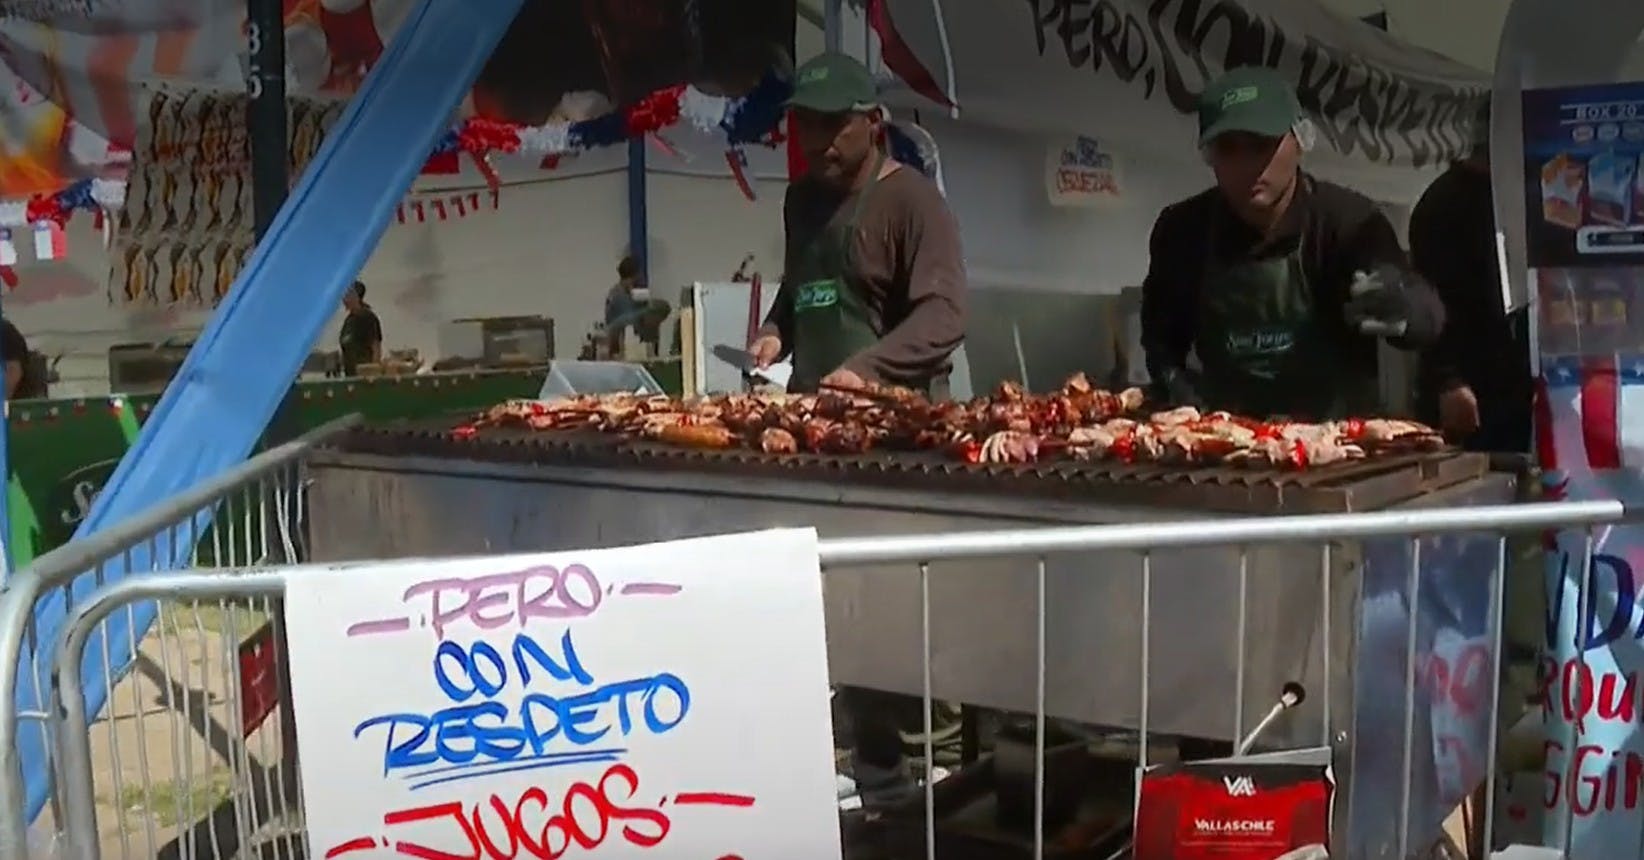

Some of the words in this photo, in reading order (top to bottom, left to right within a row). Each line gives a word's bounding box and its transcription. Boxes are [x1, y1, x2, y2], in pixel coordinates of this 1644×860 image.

[403, 563, 602, 640] PERO
[433, 628, 594, 701] CON
[353, 672, 691, 776] RESPETO
[384, 763, 671, 860] JUGOS
